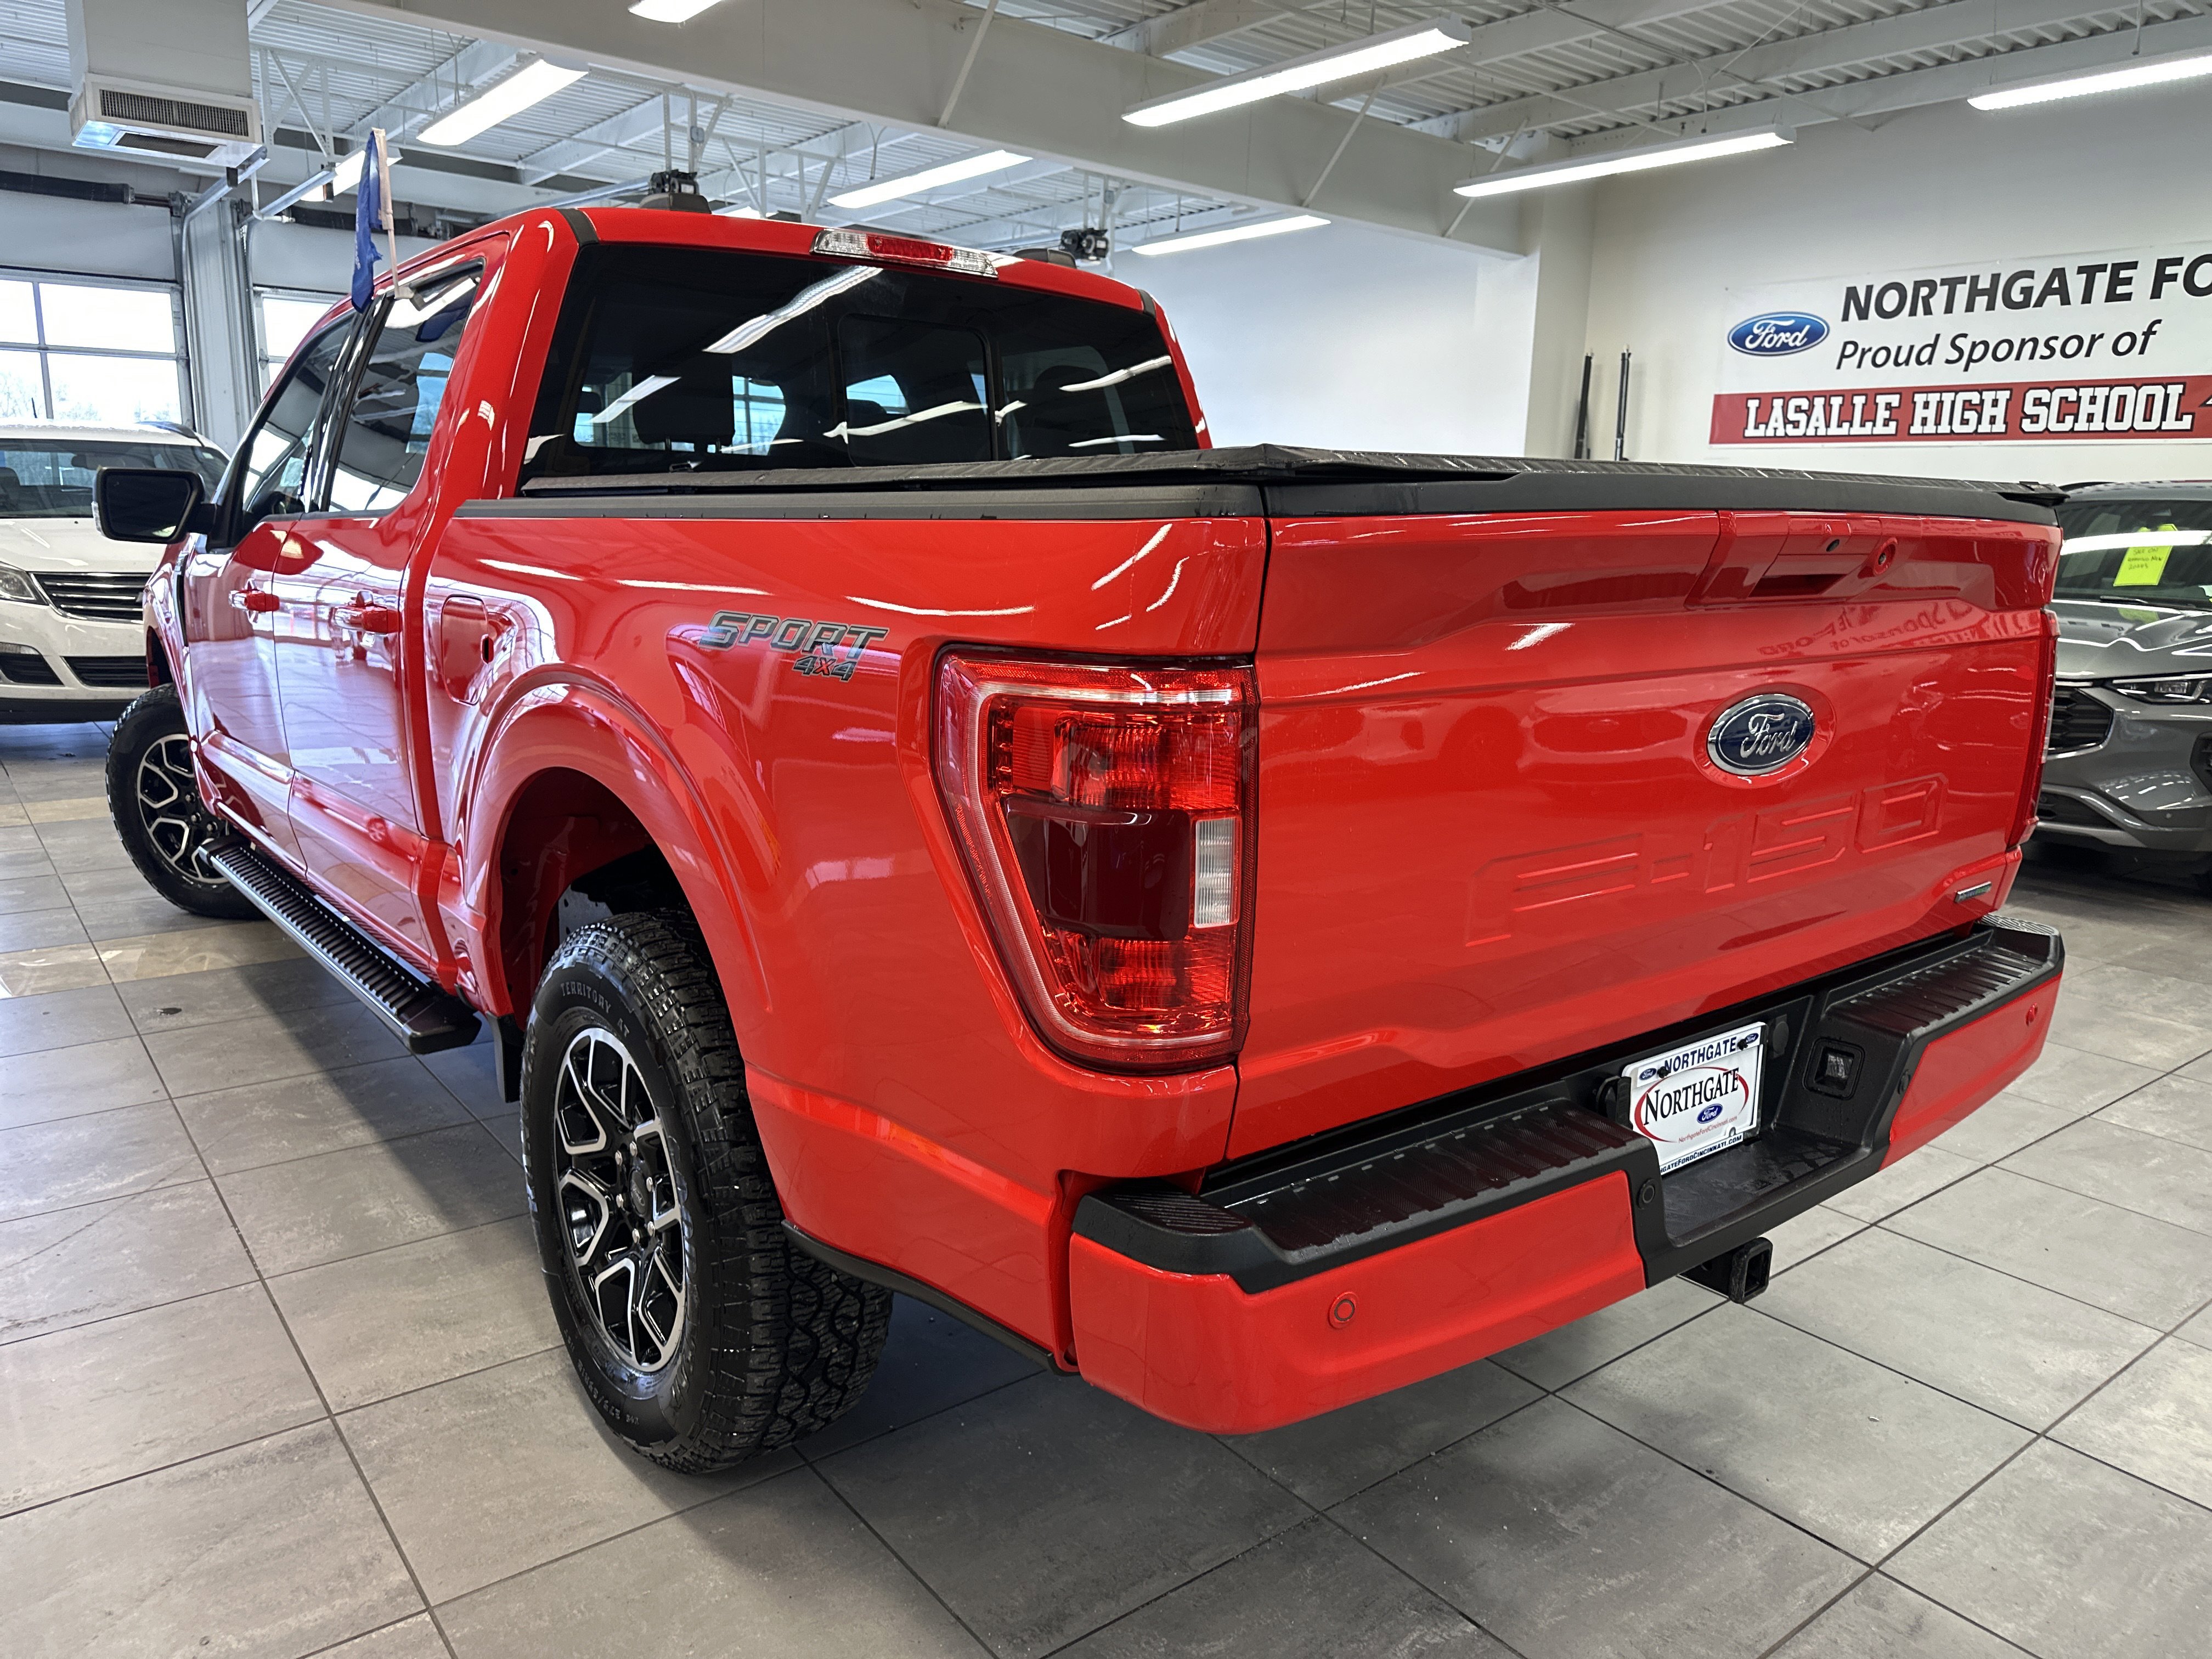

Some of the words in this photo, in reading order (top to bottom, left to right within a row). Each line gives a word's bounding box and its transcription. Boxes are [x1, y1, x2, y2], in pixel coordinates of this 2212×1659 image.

[1841, 261, 2139, 323] NORTHGATE
[1745, 319, 1810, 349] Ford
[1836, 333, 1941, 370] Proud
[1944, 332, 2103, 373] Sponsor
[2112, 318, 2163, 357] of
[1742, 393, 1902, 439] LASALLE
[1908, 387, 2012, 435] HIGH
[2021, 382, 2195, 433] SCHOOL
[698, 610, 890, 660] SPORT
[1740, 713, 1798, 759] Ford
[1465, 772, 1949, 947] F-150
[561, 981, 612, 1014] TERRITORY
[617, 1018, 630, 1038] AT
[1664, 1036, 1737, 1074] NORTHGATE
[1643, 1067, 1740, 1126] NORTHGATE
